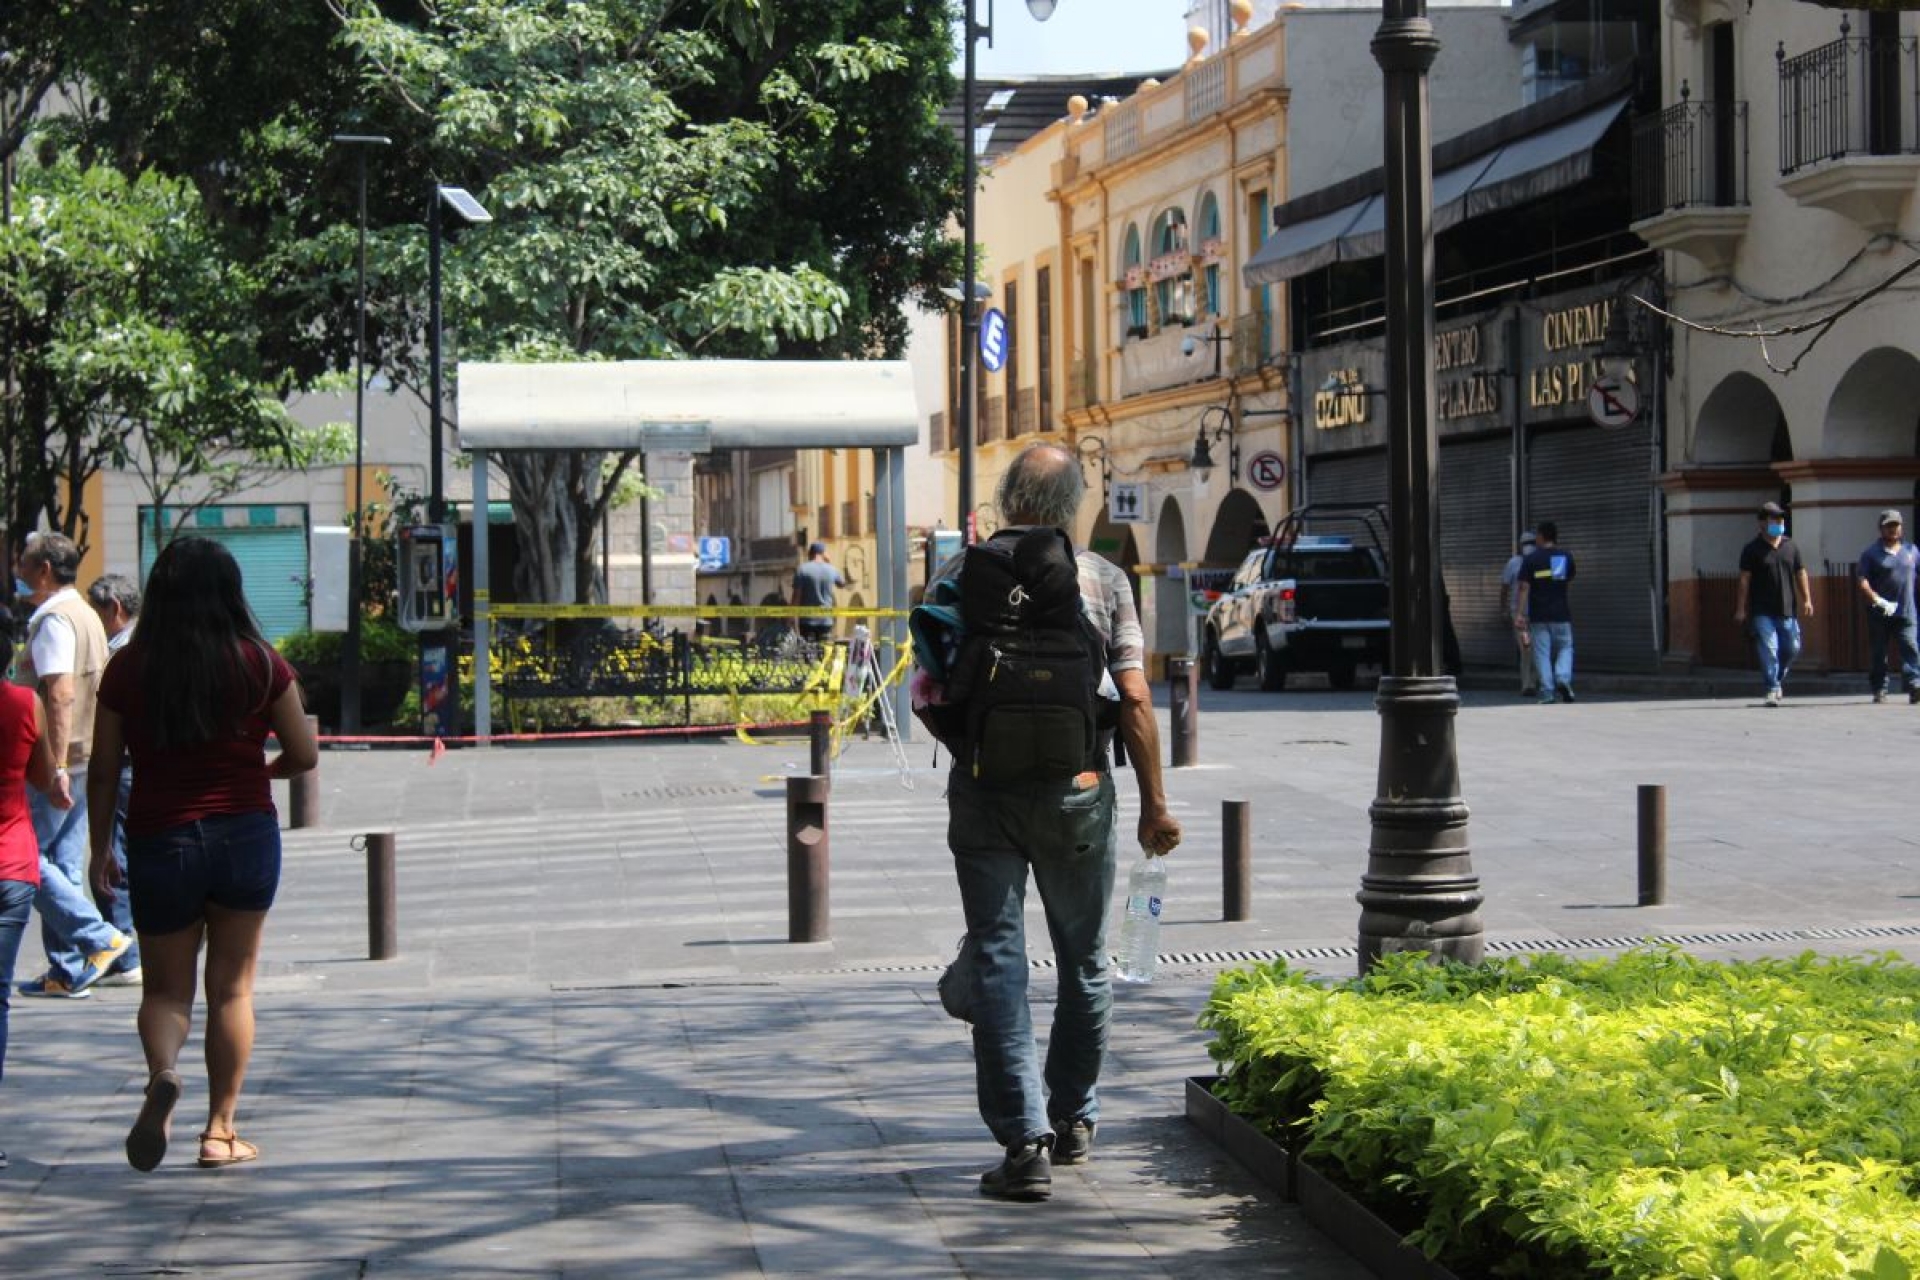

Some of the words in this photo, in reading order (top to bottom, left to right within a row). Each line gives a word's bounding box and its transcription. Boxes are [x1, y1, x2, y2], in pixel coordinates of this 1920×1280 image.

[1543, 299, 1618, 351] CINEMA
[1434, 325, 1478, 370] ENTRO
[1439, 376, 1497, 419] PLAZAS
[1530, 365, 1562, 408] LAS
